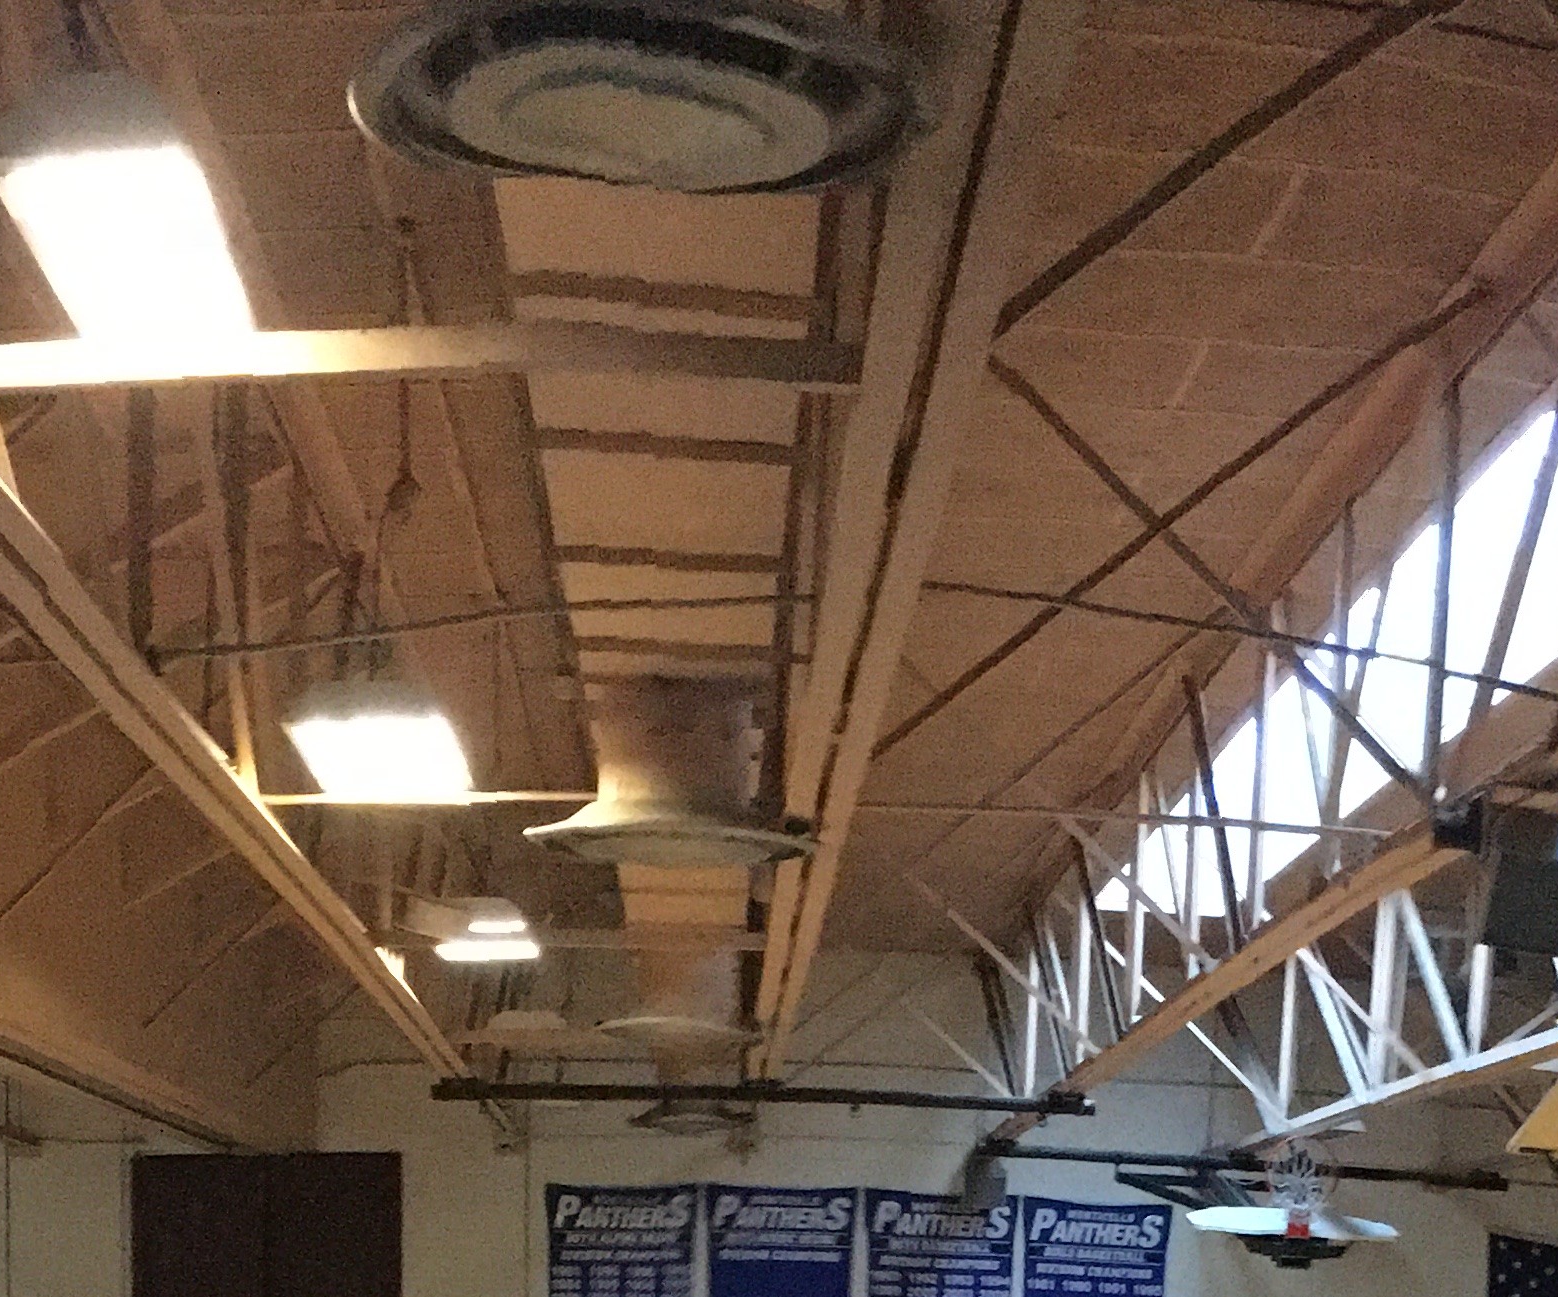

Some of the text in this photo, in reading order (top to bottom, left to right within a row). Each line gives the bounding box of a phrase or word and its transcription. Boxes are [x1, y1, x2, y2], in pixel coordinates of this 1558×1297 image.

[713, 1194, 853, 1230] PANTHERS
[873, 1200, 1011, 1238] PANTHERS
[1029, 1208, 1164, 1248] PANTHERS
